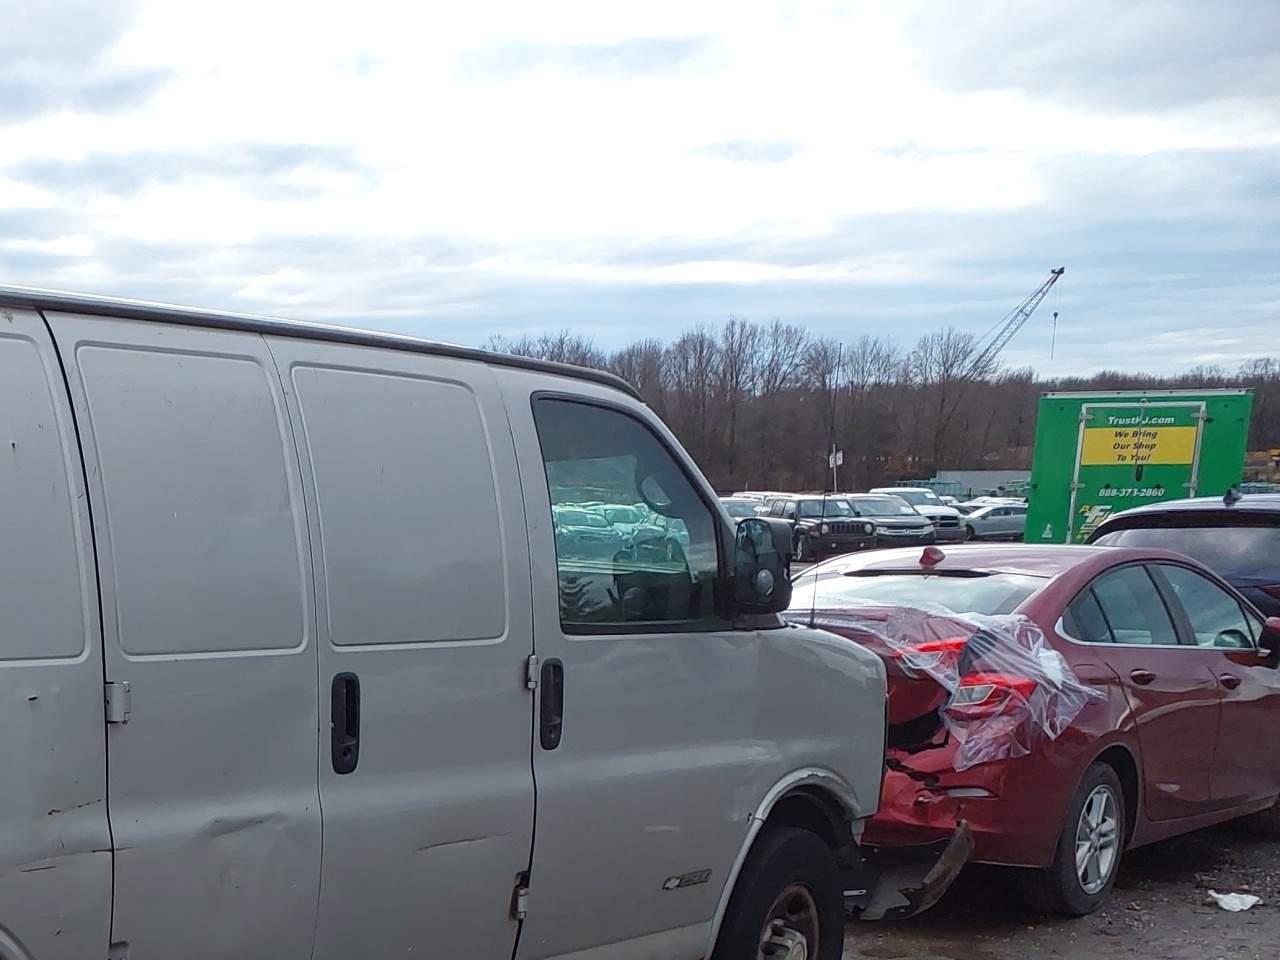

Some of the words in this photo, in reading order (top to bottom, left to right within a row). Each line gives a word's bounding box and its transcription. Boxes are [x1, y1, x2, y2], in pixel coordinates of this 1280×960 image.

[1114, 430, 1129, 438] We
[1132, 430, 1158, 439] Bring
[1113, 442, 1131, 450] Our
[1133, 442, 1156, 451] Shop
[1117, 454, 1127, 462] To
[1131, 454, 1151, 462] You!
